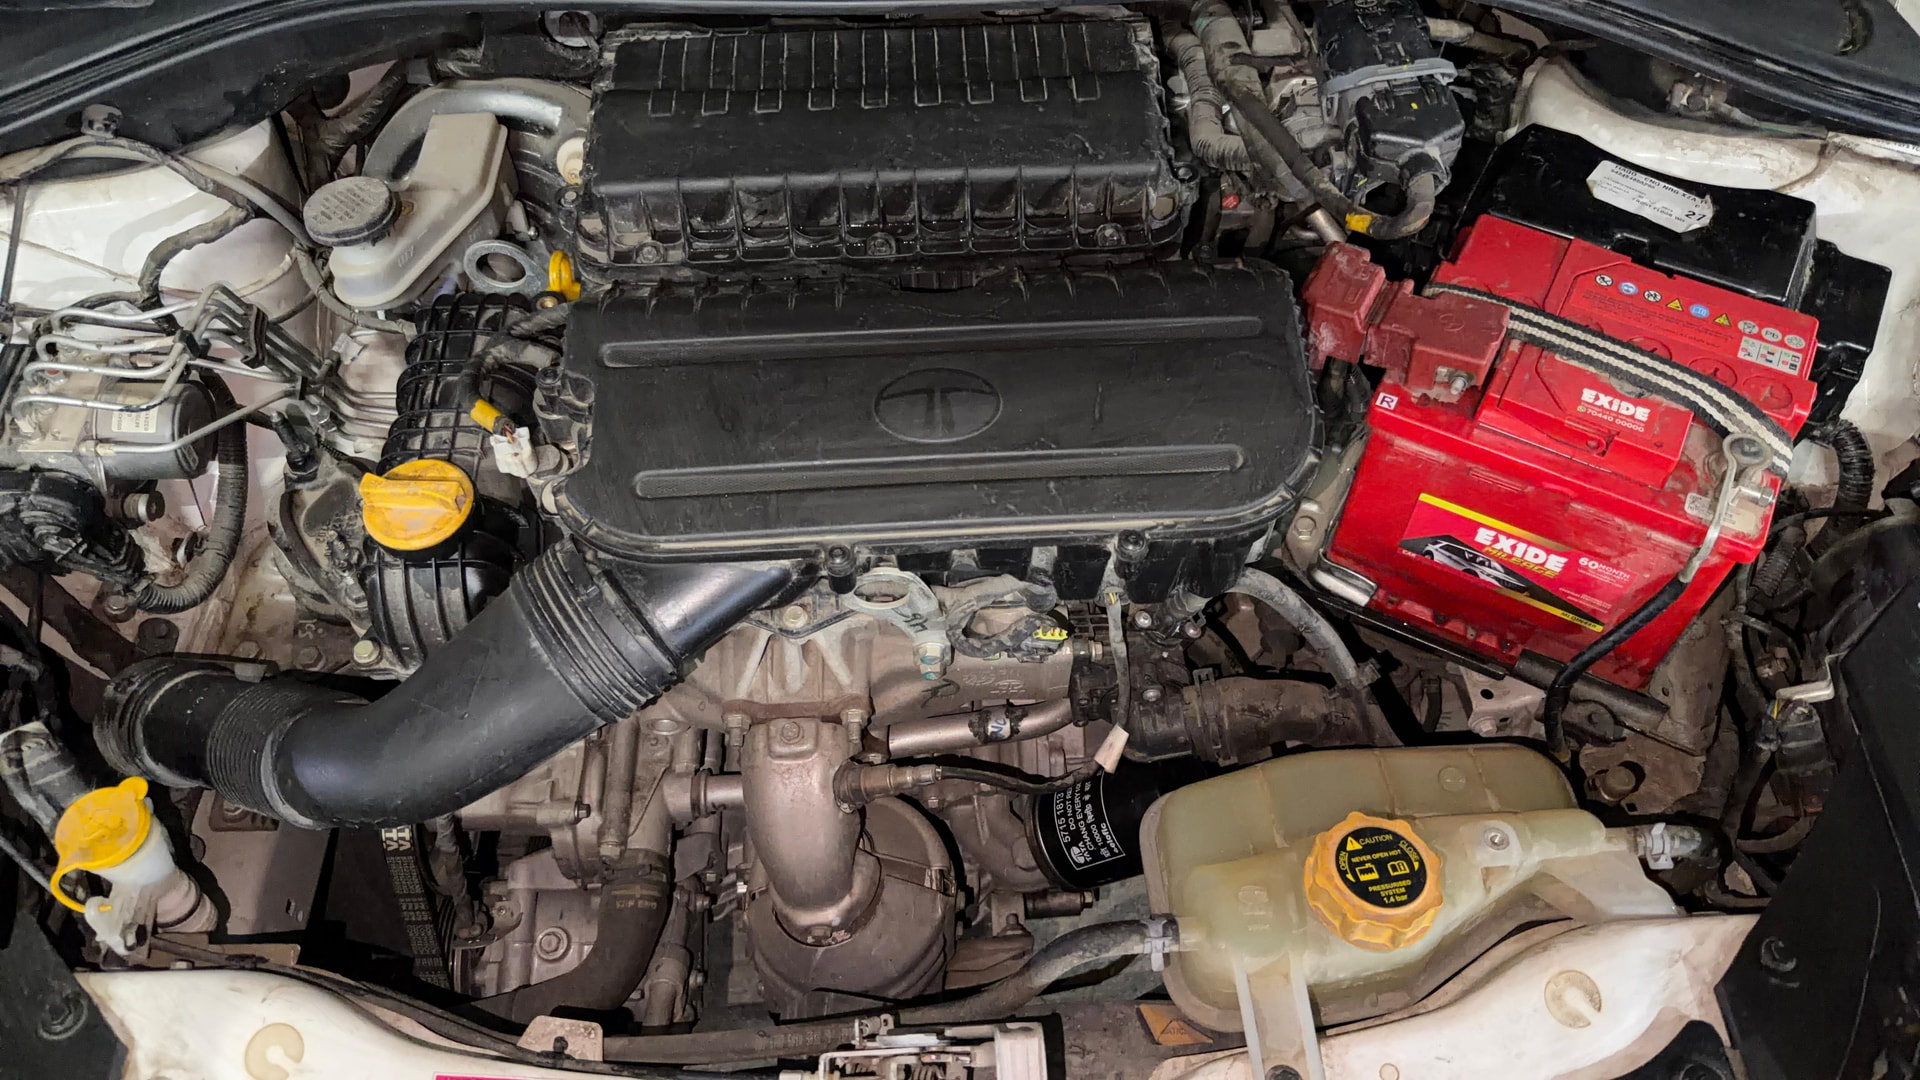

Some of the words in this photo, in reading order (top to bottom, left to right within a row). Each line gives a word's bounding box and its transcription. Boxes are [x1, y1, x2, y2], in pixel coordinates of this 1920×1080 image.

[1684, 210, 1707, 221] 27
[1380, 395, 1394, 409] R
[1581, 387, 1651, 422] EXIDE
[1586, 408, 1614, 422] 70440
[1615, 417, 1645, 432] 00000
[1475, 527, 1569, 573] EXIDE
[1578, 557, 1599, 569] 60
[1598, 563, 1631, 579] MONTH
[1056, 792, 1064, 815] 1813
[1074, 792, 1083, 820] EVERY
[1057, 817, 1071, 843] 5715
[1068, 817, 1076, 830] DO
[1090, 824, 1104, 846] 10000
[1359, 834, 1393, 845] CAUTION
[1078, 841, 1093, 862] TATA
[1339, 850, 1347, 870] OPEN
[1351, 854, 1371, 863] NEVER
[1371, 851, 1389, 860] OPEN
[1389, 849, 1401, 857] HOT
[1399, 840, 1420, 861] CLOSE
[1368, 879, 1412, 892] PRESSURISED
[1380, 887, 1406, 897] SYSTEM
[1383, 896, 1395, 904] 1.4
[1395, 894, 1408, 902] bar
